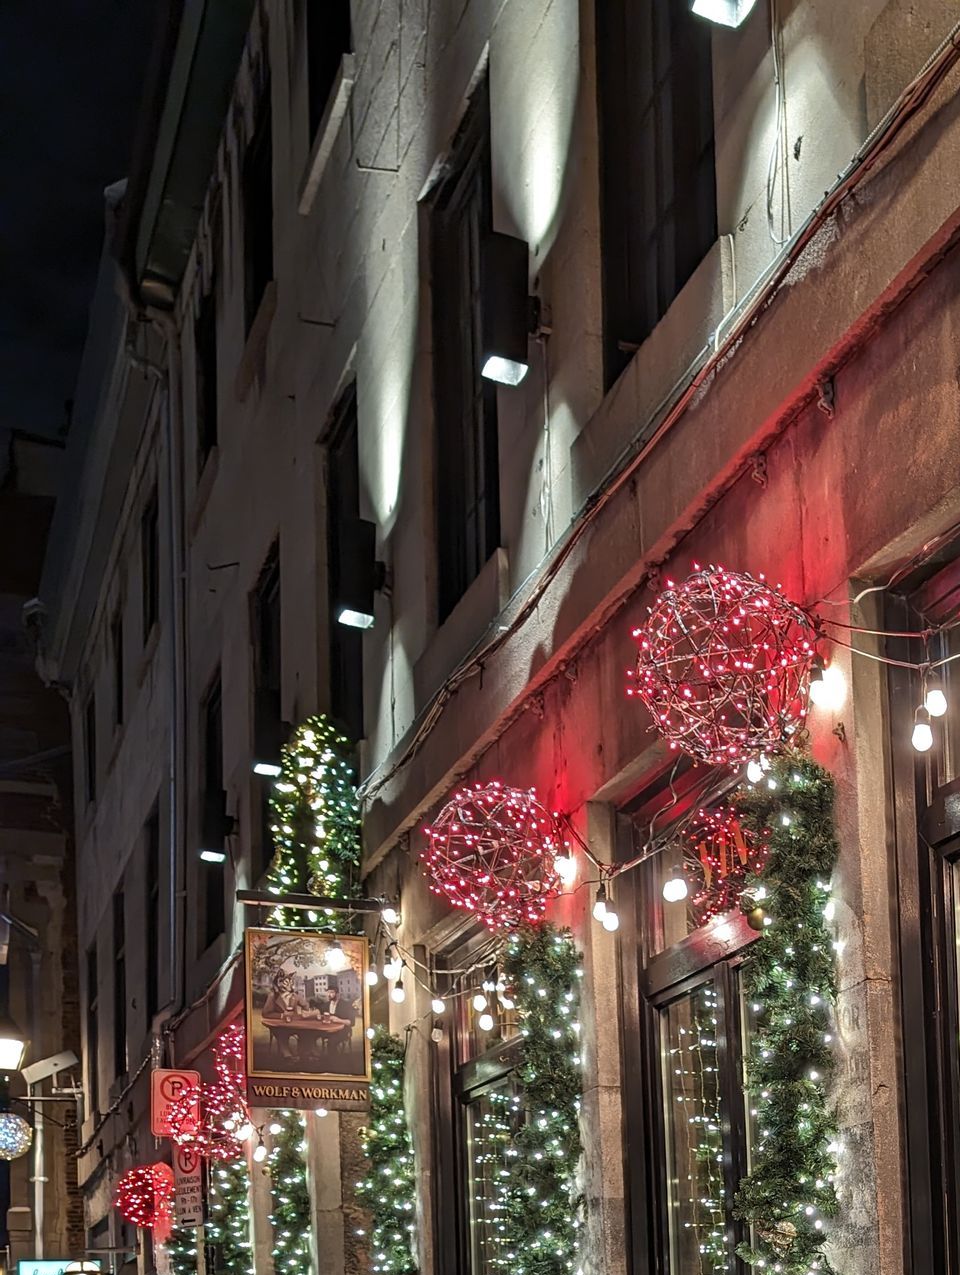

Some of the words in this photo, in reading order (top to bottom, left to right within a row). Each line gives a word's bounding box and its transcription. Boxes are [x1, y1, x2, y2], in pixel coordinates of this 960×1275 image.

[252, 1085, 290, 1097] WOLF
[291, 1087, 300, 1097] &
[301, 1087, 367, 1100] WORKMAN
